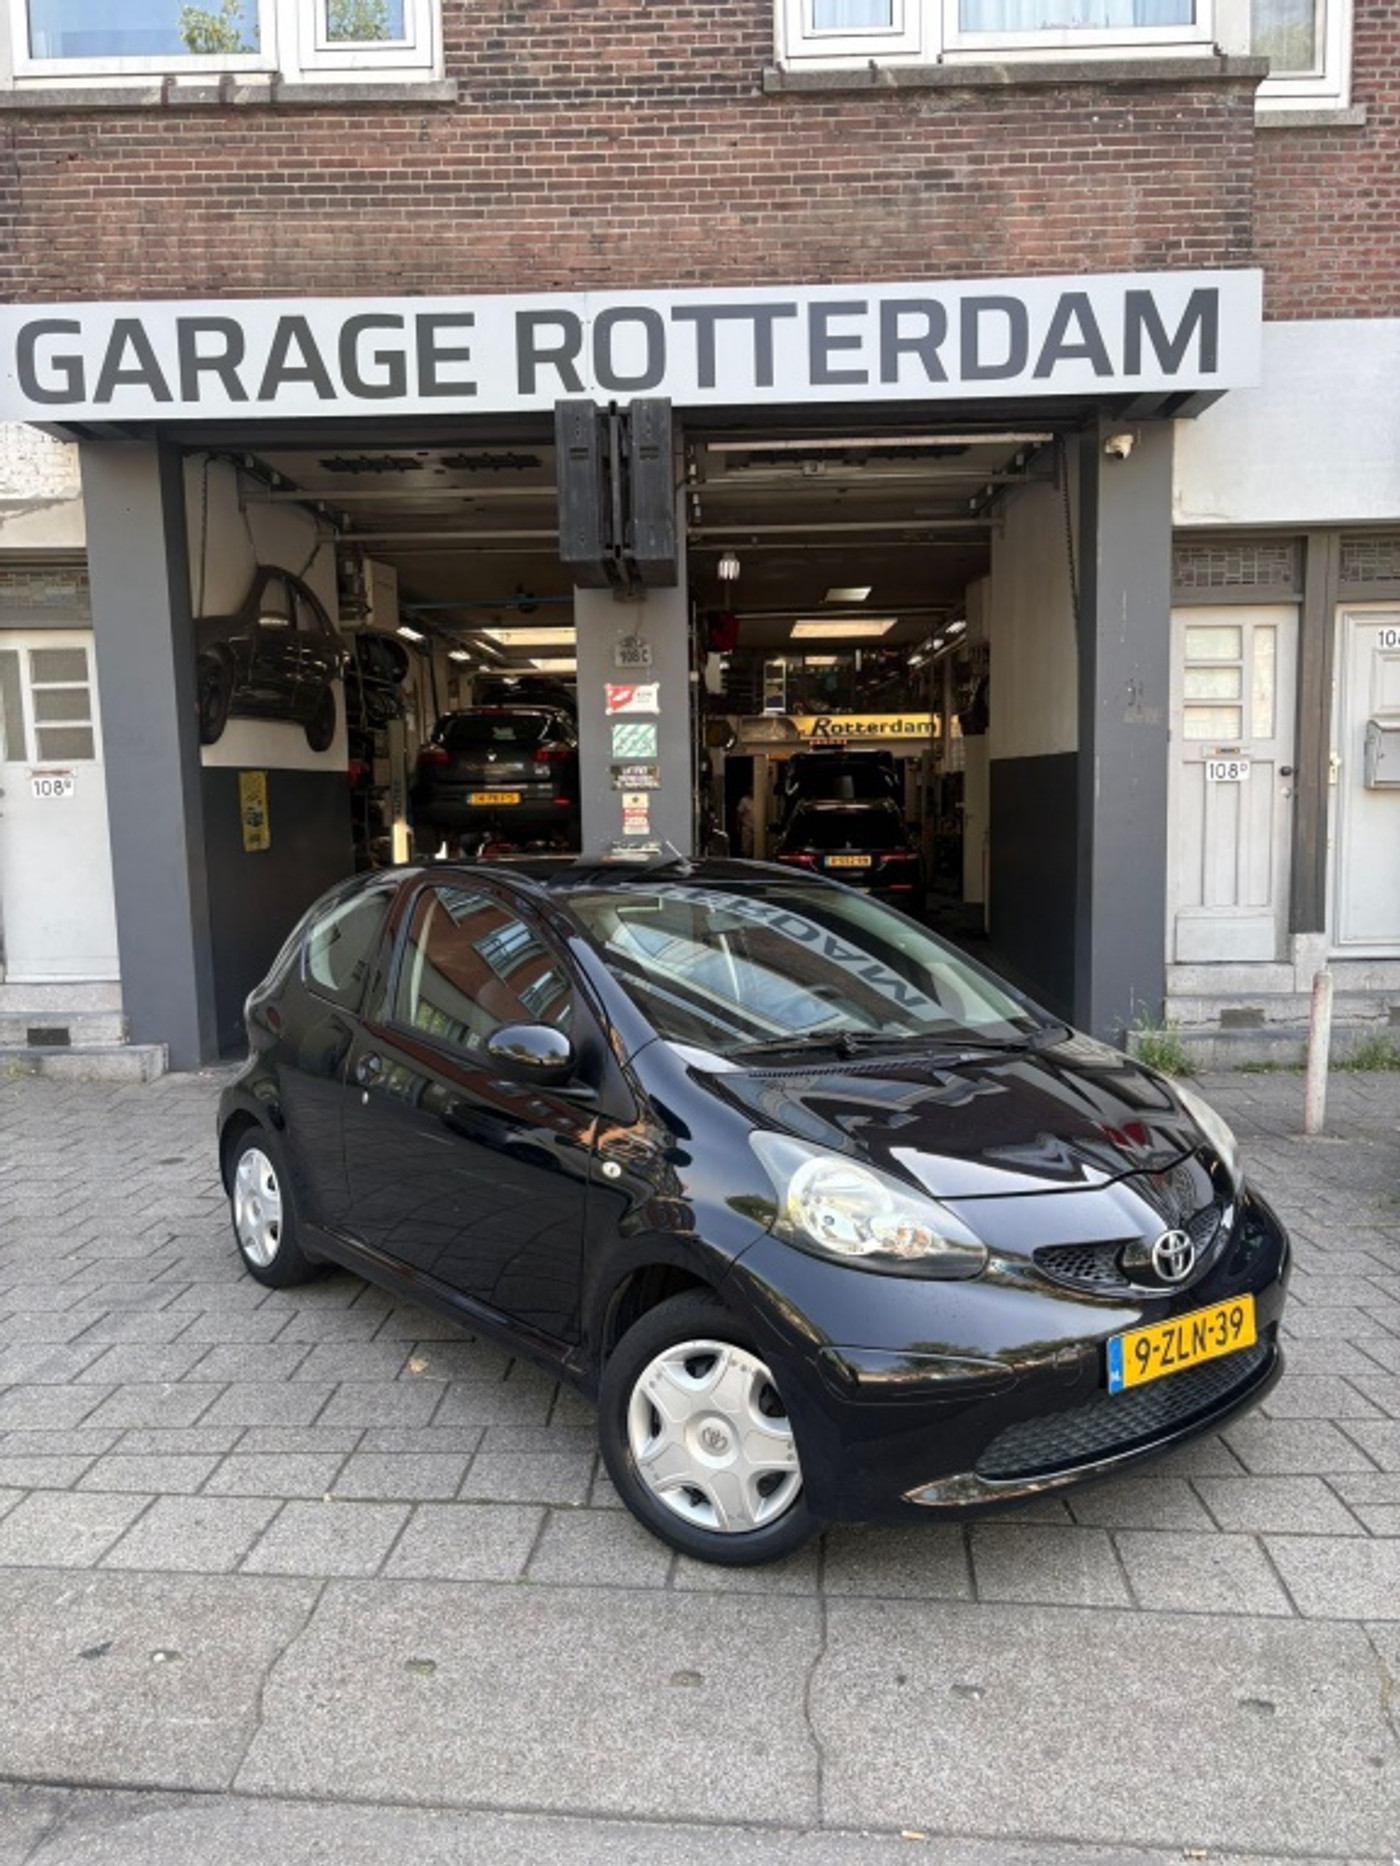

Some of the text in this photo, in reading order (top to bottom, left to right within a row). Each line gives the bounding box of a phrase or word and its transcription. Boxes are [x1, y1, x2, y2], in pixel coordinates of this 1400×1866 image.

[15, 287, 1220, 405] GARAGE ROTTERDAM
[1378, 630, 1400, 648] 10
[811, 716, 937, 738] Rotterdam
[1135, 1306, 1243, 1375] 9-ZLN-39
